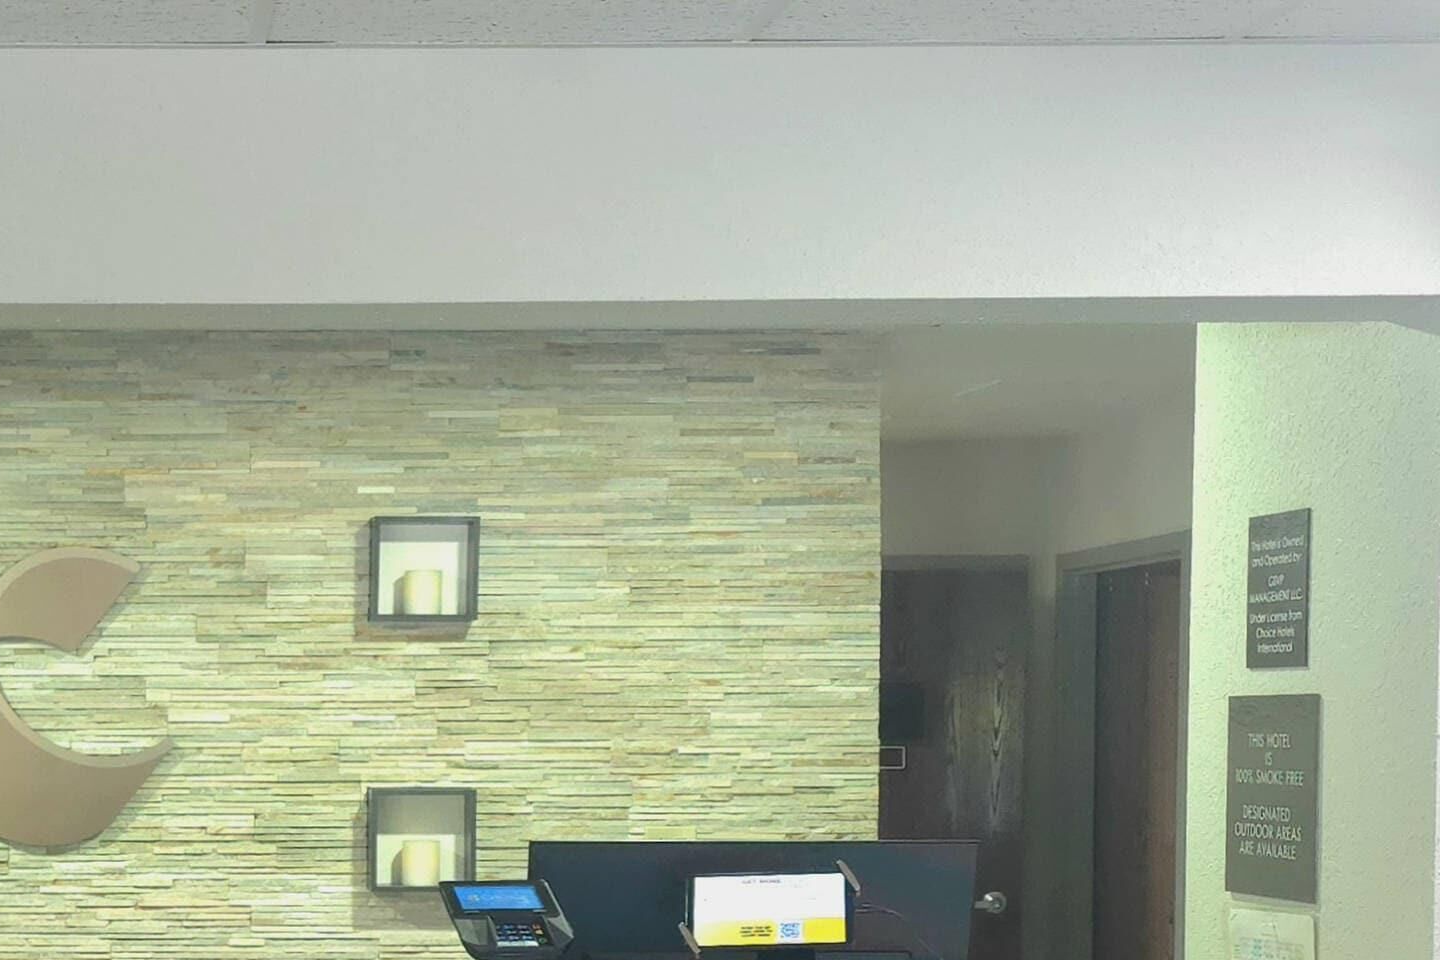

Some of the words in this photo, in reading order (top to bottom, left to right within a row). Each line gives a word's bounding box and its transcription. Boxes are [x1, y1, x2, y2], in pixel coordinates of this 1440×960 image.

[1252, 556, 1263, 568] and
[1264, 552, 1292, 567] Operated
[1249, 588, 1290, 604] MANAGEMENT
[1256, 627, 1276, 639] Choice
[1248, 733, 1264, 748] THIS
[1266, 733, 1291, 748] HOTEL
[1265, 751, 1273, 766] IS
[1235, 768, 1253, 784] 100%
[1255, 769, 1283, 785] SMOKE
[1286, 770, 1304, 786] FREE
[1243, 804, 1291, 822] DESIGNATED
[1234, 821, 1273, 839] OUTDOOR
[1276, 825, 1302, 842] AREAS
[1239, 840, 1254, 855] ARE
[1256, 841, 1296, 860] AVAILABLE
